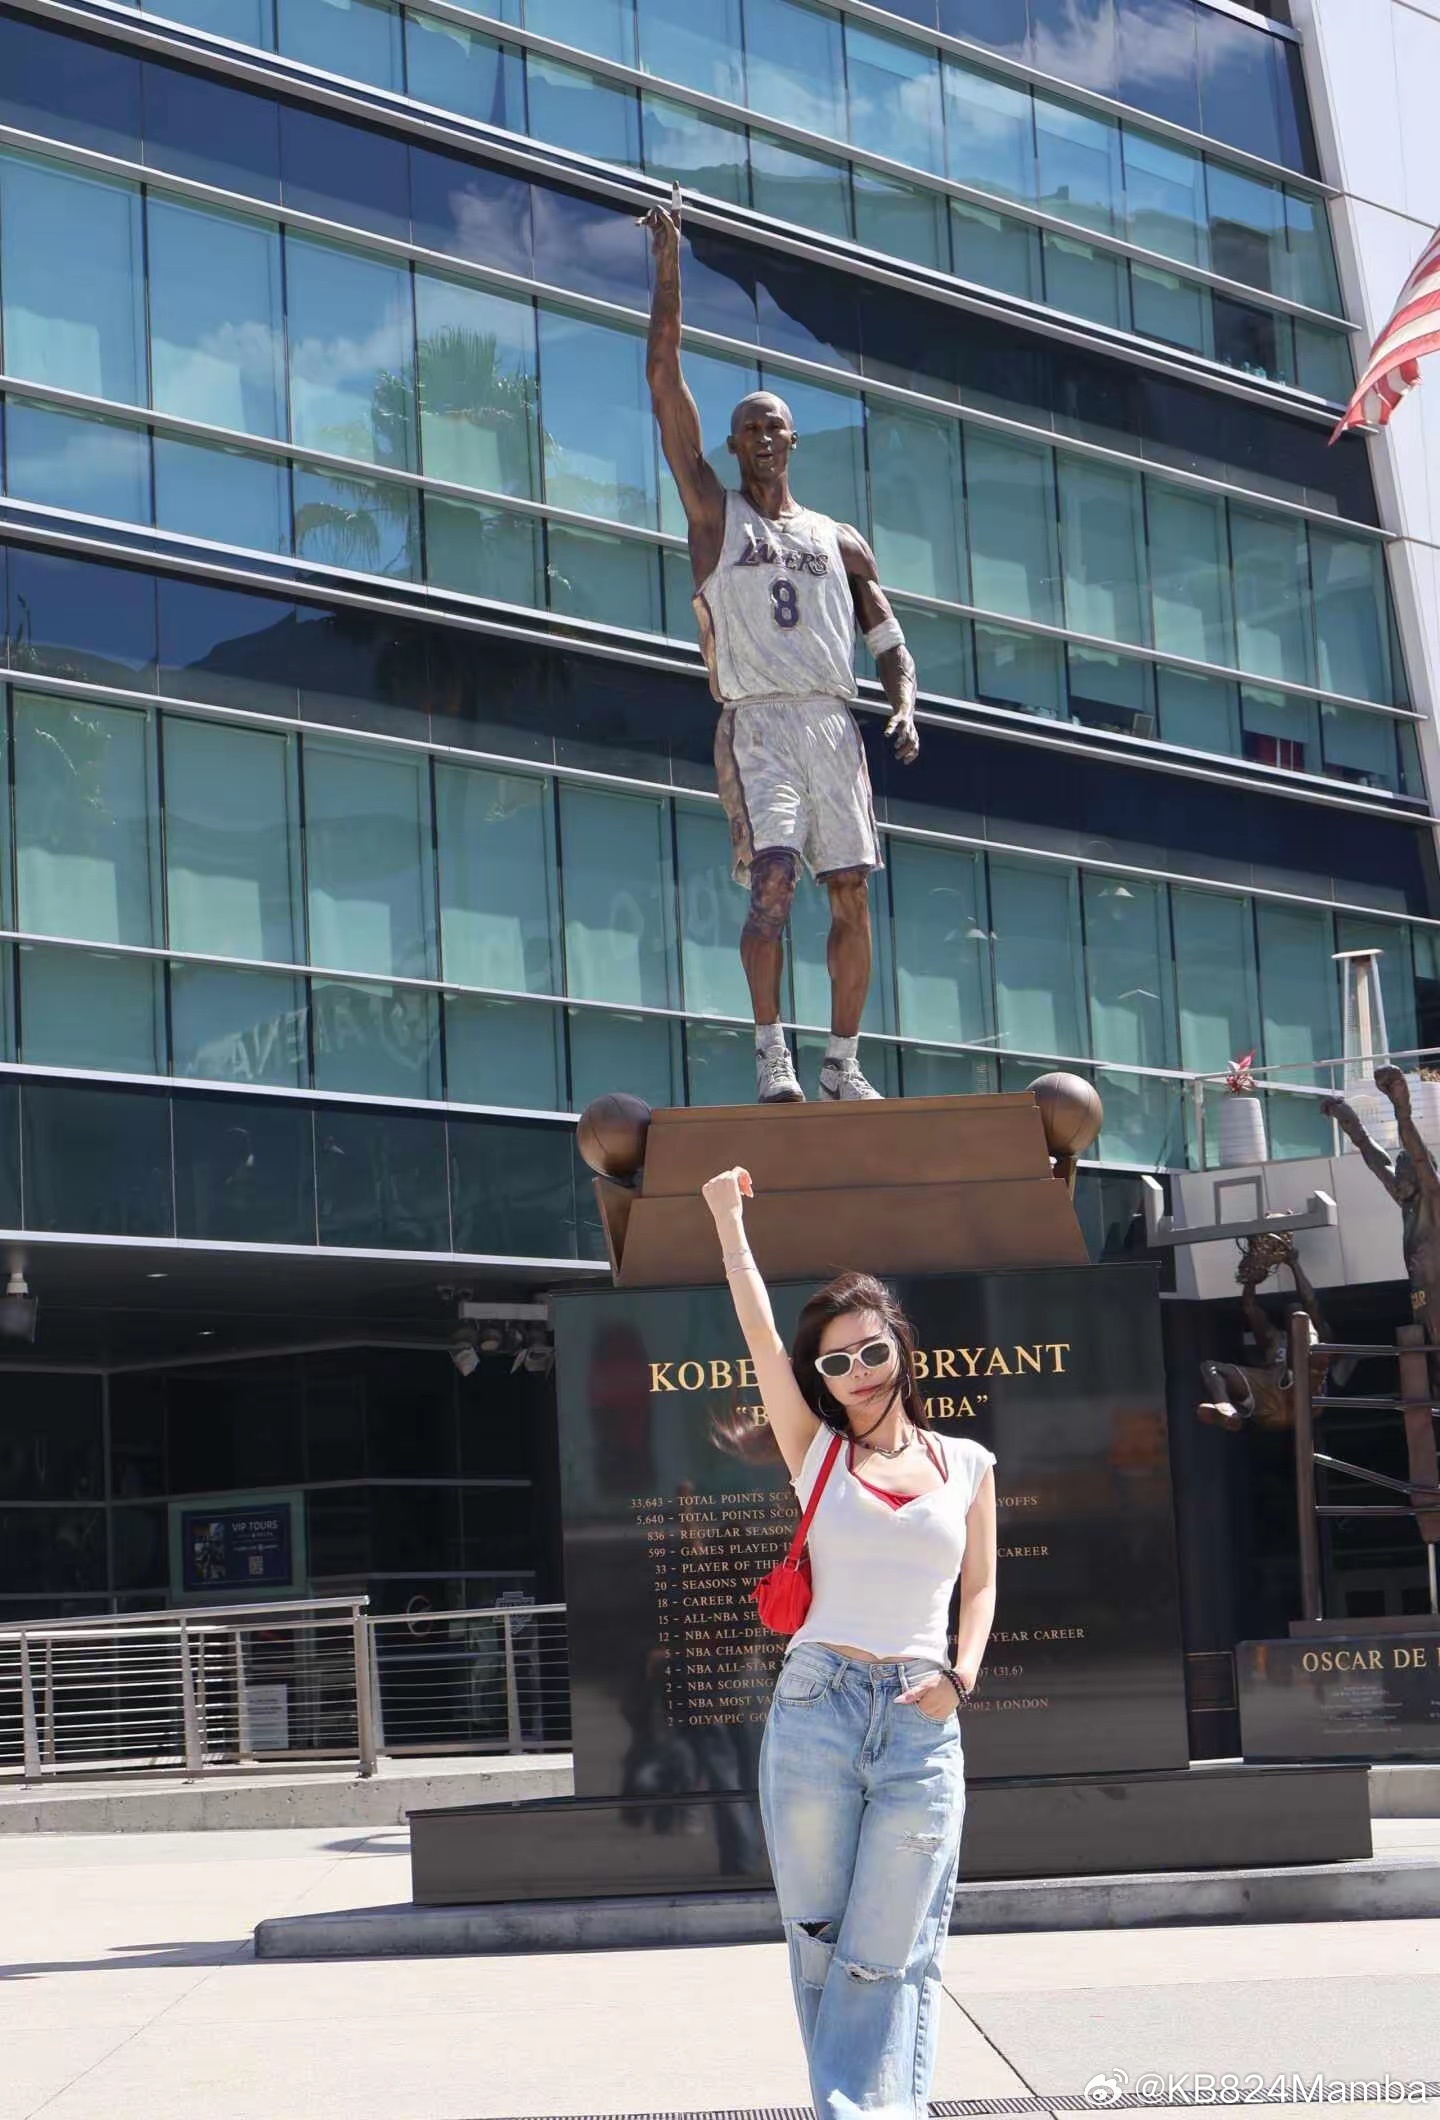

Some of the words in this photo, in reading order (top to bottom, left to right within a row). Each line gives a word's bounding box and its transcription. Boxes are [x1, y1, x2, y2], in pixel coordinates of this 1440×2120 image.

[771, 577, 799, 631] 8
[648, 1359, 759, 1393] KOBE
[911, 1343, 1071, 1378] BRYANT
[679, 1495, 716, 1506] TOTAL
[721, 1493, 765, 1505] POINTS
[997, 1496, 1038, 1507] YOFFS
[636, 1513, 664, 1525] 5,640
[679, 1511, 717, 1523] TOTAL
[722, 1509, 766, 1521] POINTS
[231, 1521, 247, 1532] VIP
[250, 1519, 279, 1531] TOURS
[680, 1528, 741, 1540] REGULAR
[745, 1525, 793, 1537] SEASON
[681, 1545, 724, 1557] GAMES
[730, 1543, 778, 1554] PLAYED
[997, 1546, 1049, 1558] CAREER
[682, 1561, 729, 1573] PLAYER
[734, 1560, 750, 1571] OF
[755, 1559, 779, 1570] THE
[654, 1581, 667, 1592] 20
[682, 1578, 737, 1590] SEASONS
[657, 1599, 668, 1608] 18
[683, 1595, 733, 1607] CAREER
[658, 1615, 669, 1625] 15
[683, 1611, 739, 1624] ALL-NBA
[659, 1632, 669, 1642] 12
[685, 1630, 711, 1641] NBA
[1034, 1628, 1085, 1640] CAREER
[686, 1647, 712, 1657] NBA
[1302, 1650, 1384, 1673] OSCAR
[1393, 1648, 1427, 1669] DE
[687, 1664, 713, 1675] NBA
[717, 1660, 777, 1673] ALL-STAR
[687, 1681, 713, 1692] NBA
[718, 1678, 774, 1690] SCORING
[688, 1698, 714, 1709] NBA
[719, 1696, 752, 1707] MOST
[996, 1698, 1049, 1711] LONDON
[689, 1713, 745, 1726] OLYMPIC
